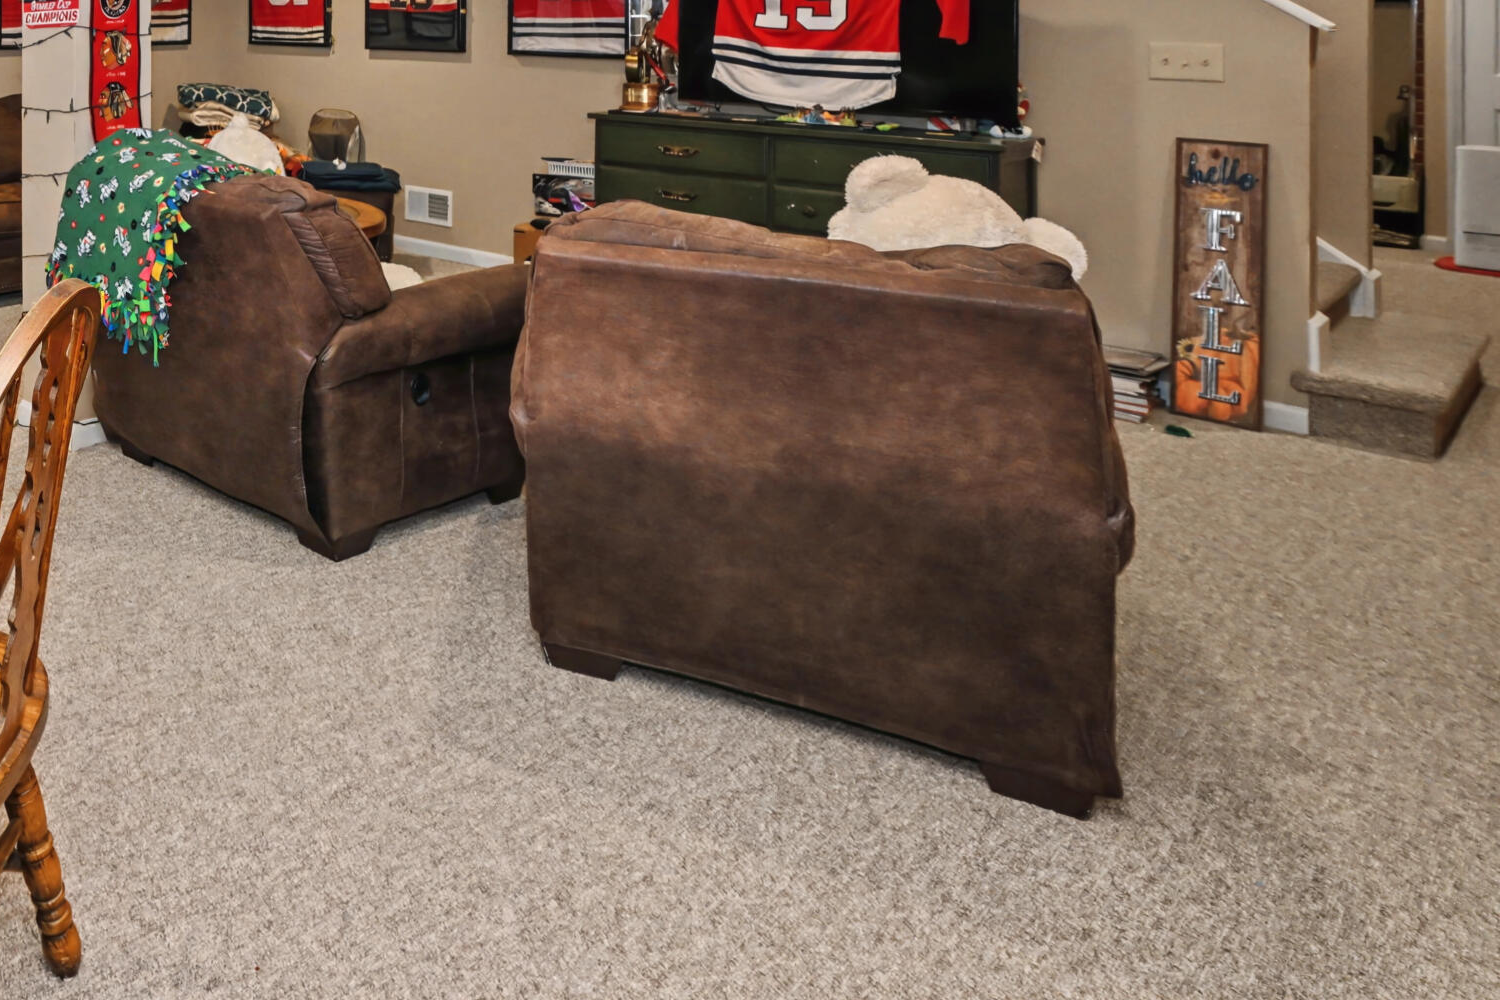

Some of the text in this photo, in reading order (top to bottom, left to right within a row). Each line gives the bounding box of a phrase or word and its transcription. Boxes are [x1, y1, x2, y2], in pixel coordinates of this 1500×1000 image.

[25, 10, 78, 24] CHAMPIONS
[1185, 151, 1257, 192] hello
[1190, 207, 1251, 405] FALL
